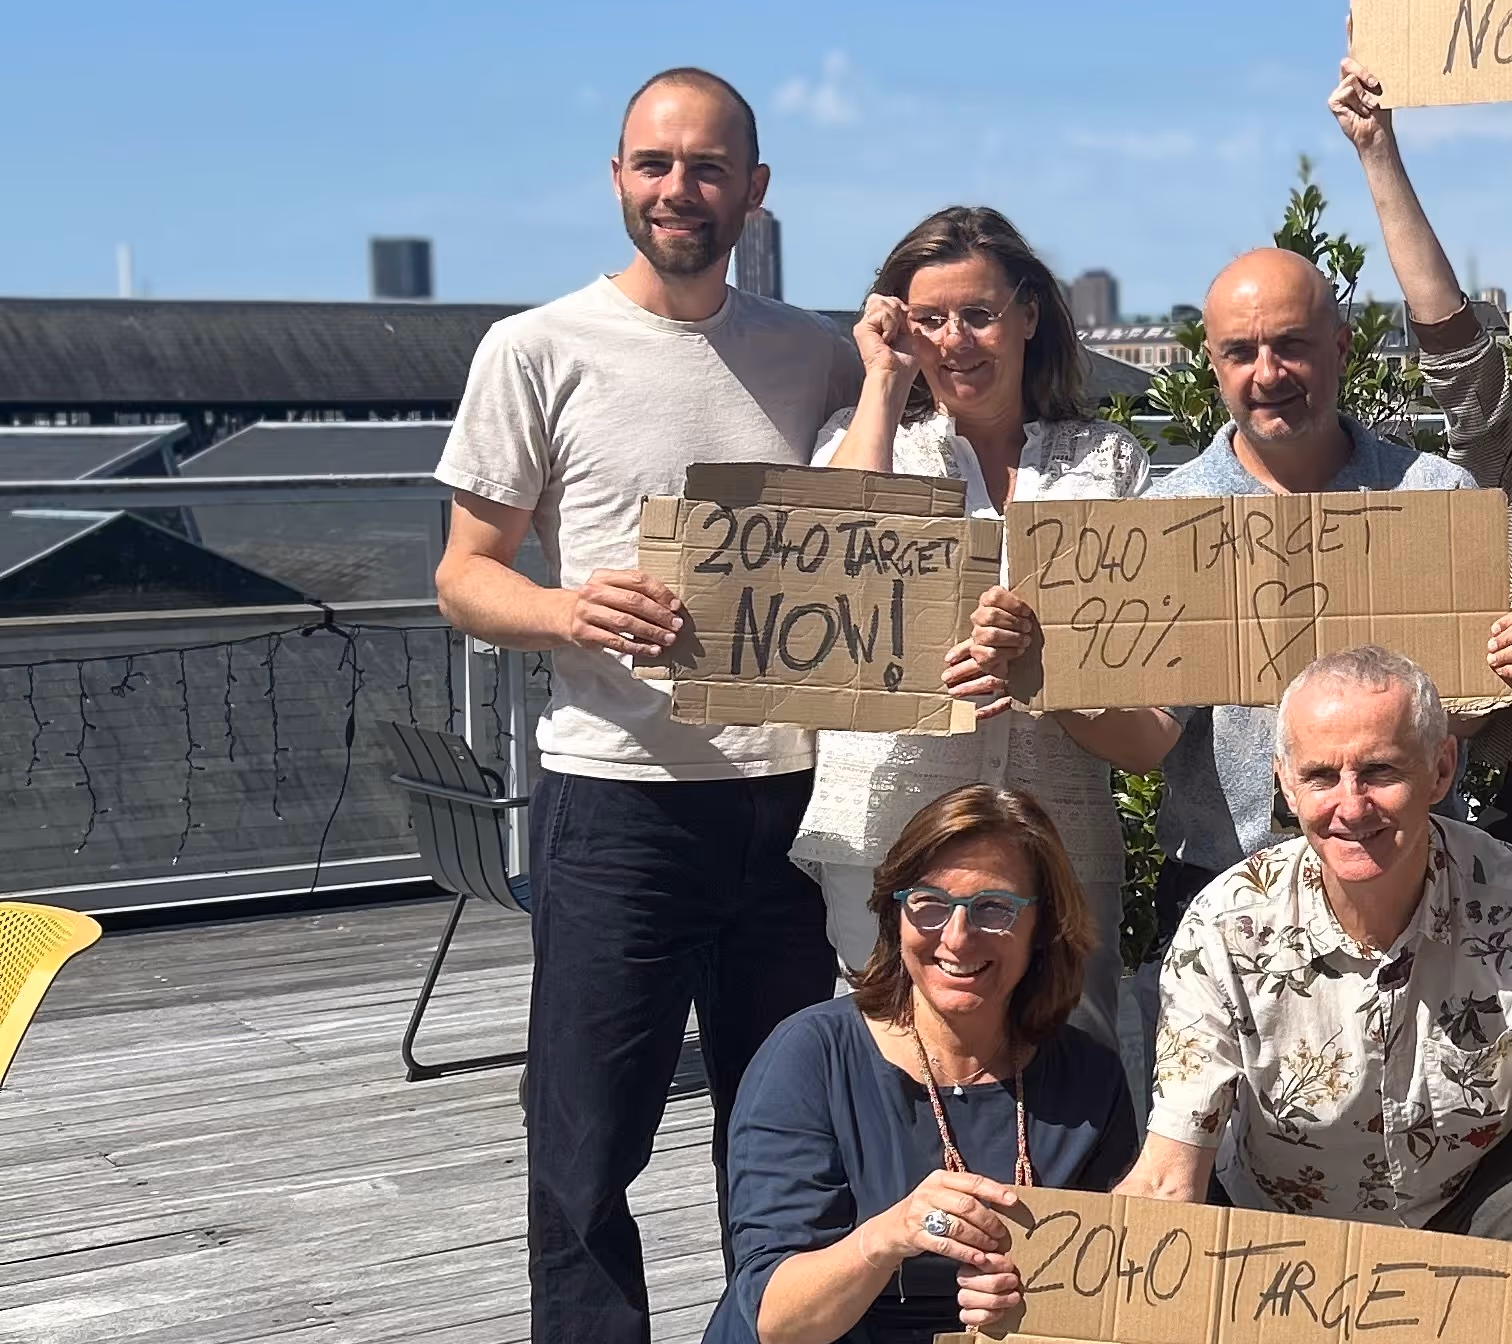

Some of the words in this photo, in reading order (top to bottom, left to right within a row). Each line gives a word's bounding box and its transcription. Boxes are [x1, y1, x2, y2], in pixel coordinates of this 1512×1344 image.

[694, 505, 830, 576] 2040
[836, 519, 960, 578] TARGET
[1026, 518, 1148, 589] 2040
[1162, 505, 1403, 574] TARGET
[730, 578, 905, 693] NOW!
[1070, 594, 1186, 670] 90%
[1020, 1210, 1193, 1307] 2040
[1203, 1240, 1511, 1340] TARGET
